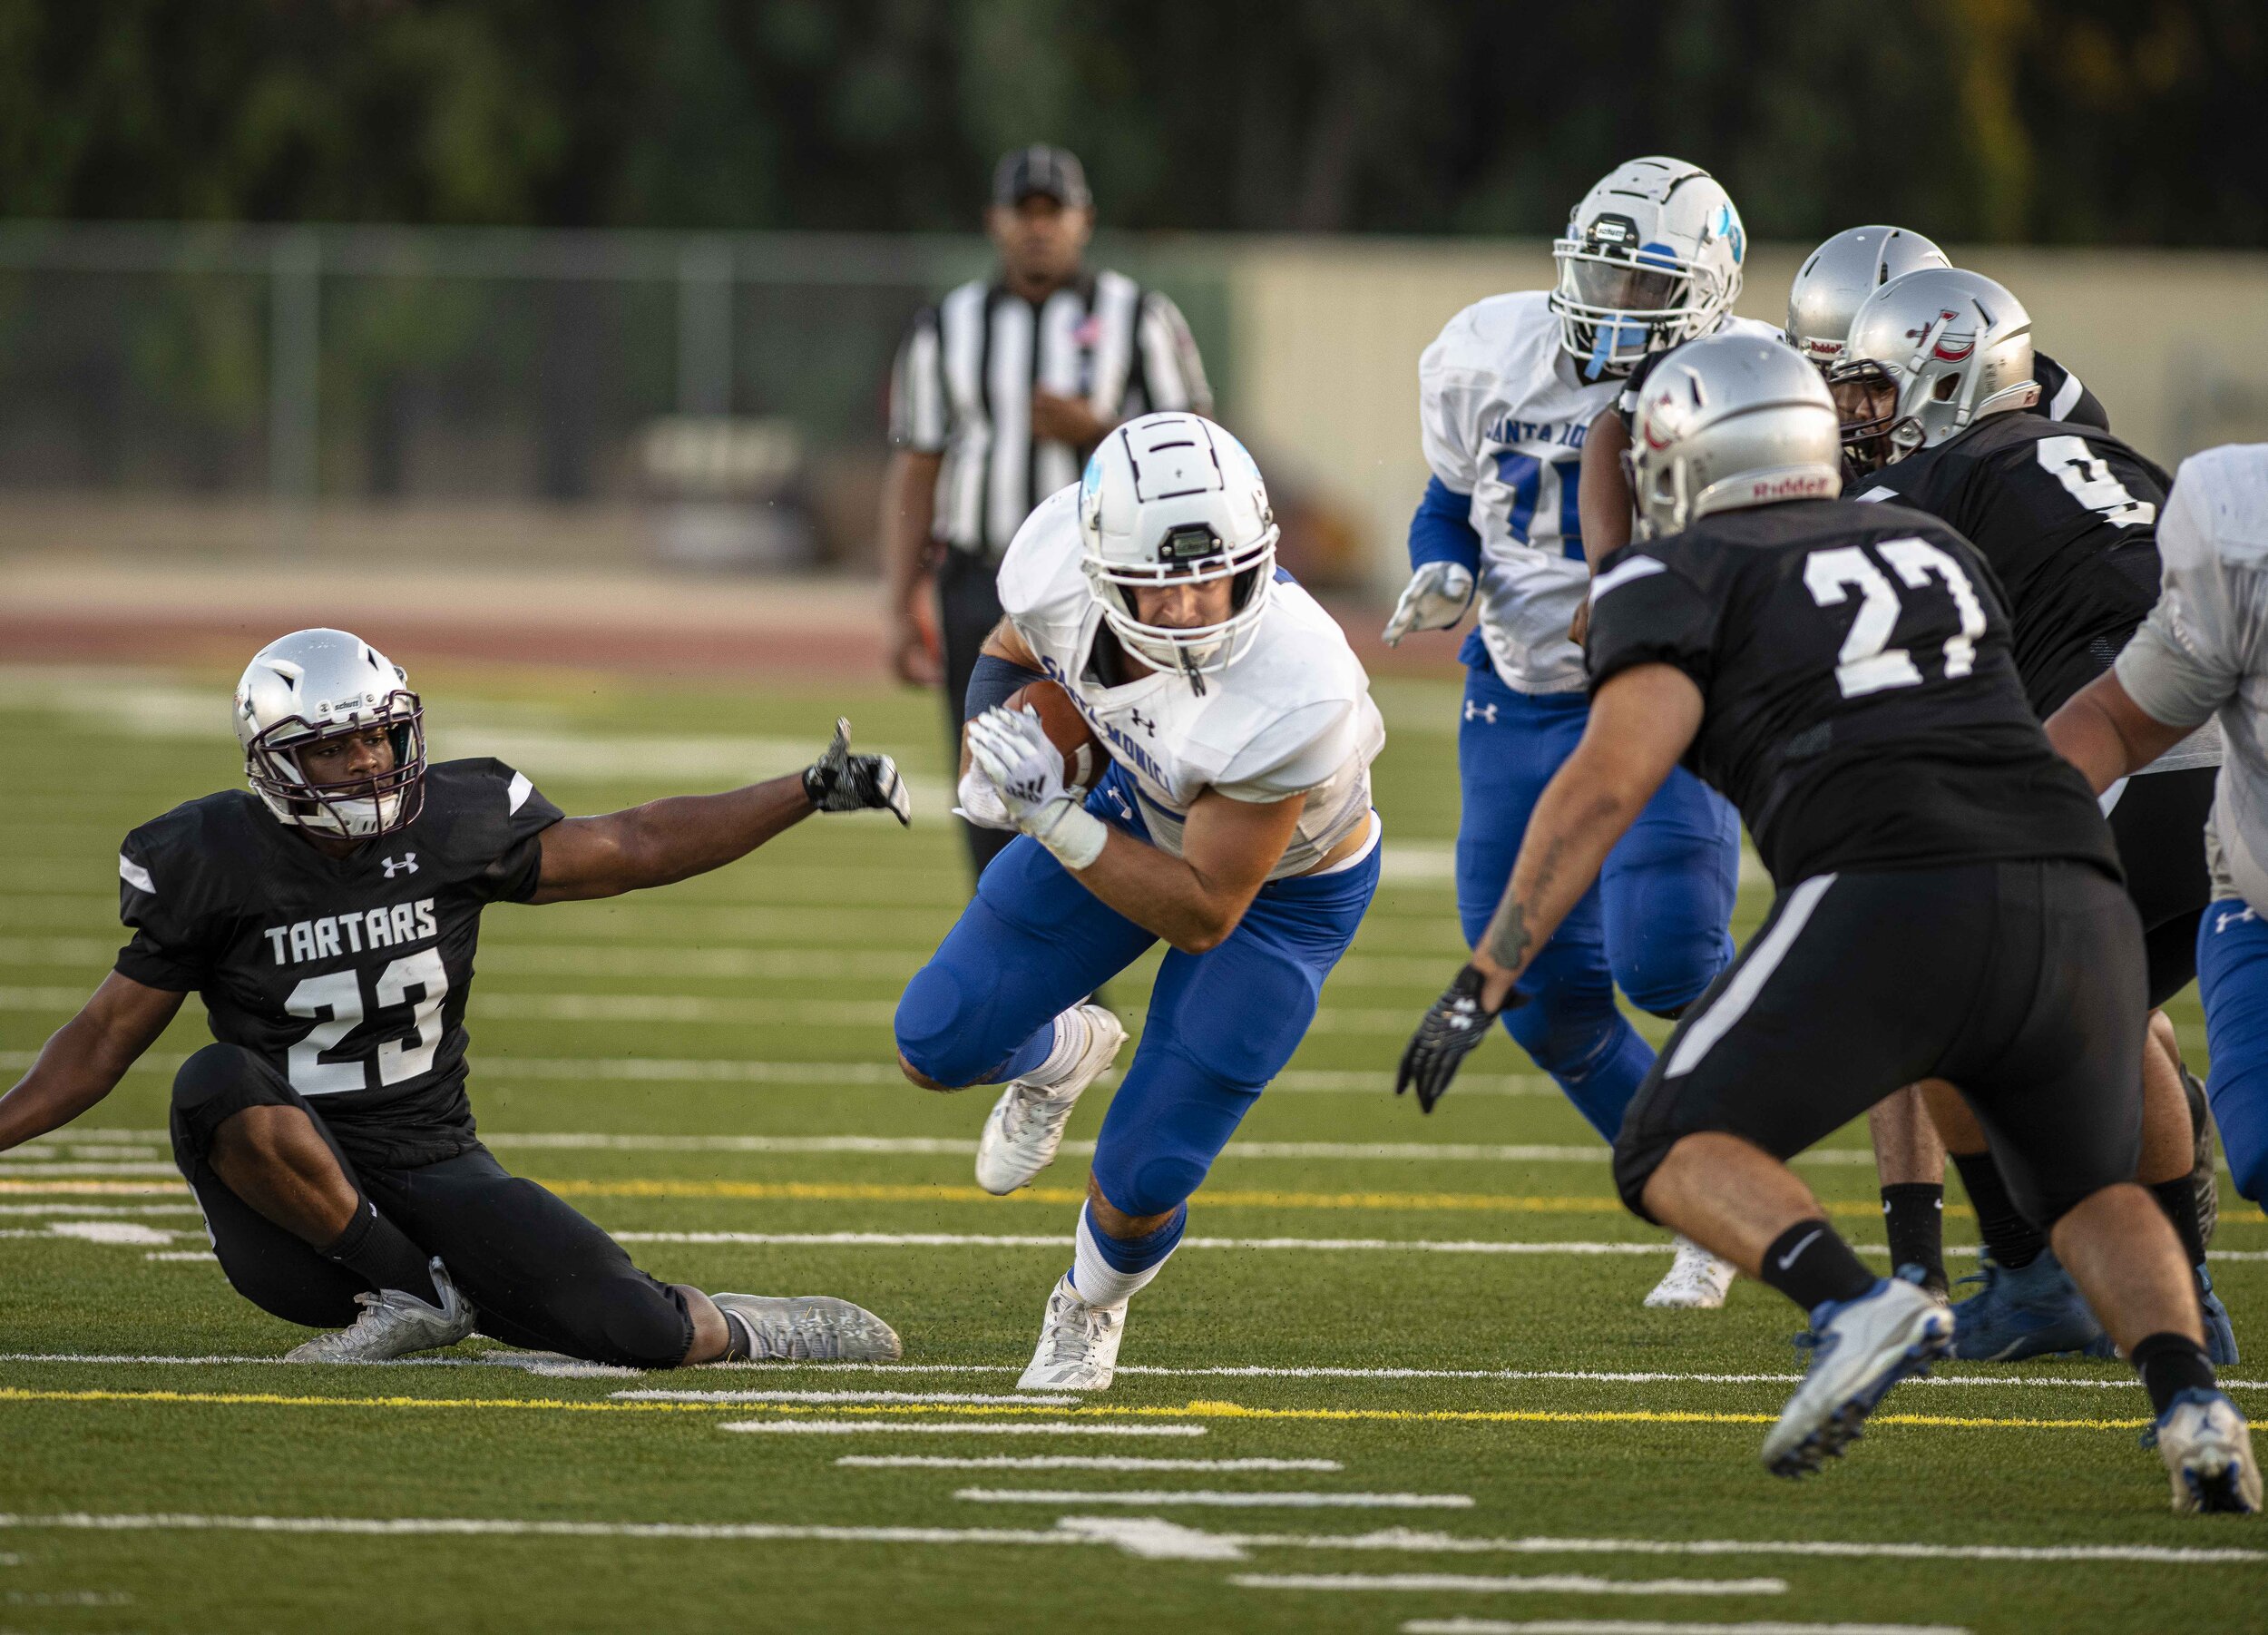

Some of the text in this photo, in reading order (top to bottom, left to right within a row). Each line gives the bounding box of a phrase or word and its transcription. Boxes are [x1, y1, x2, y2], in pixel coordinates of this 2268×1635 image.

[1485, 418, 1552, 444] ANTA
[1803, 537, 1987, 699] 27
[334, 700, 359, 711] schutt
[1104, 720, 1178, 797] MONIC
[264, 897, 438, 965] TARTARS
[284, 946, 449, 1096] 23
